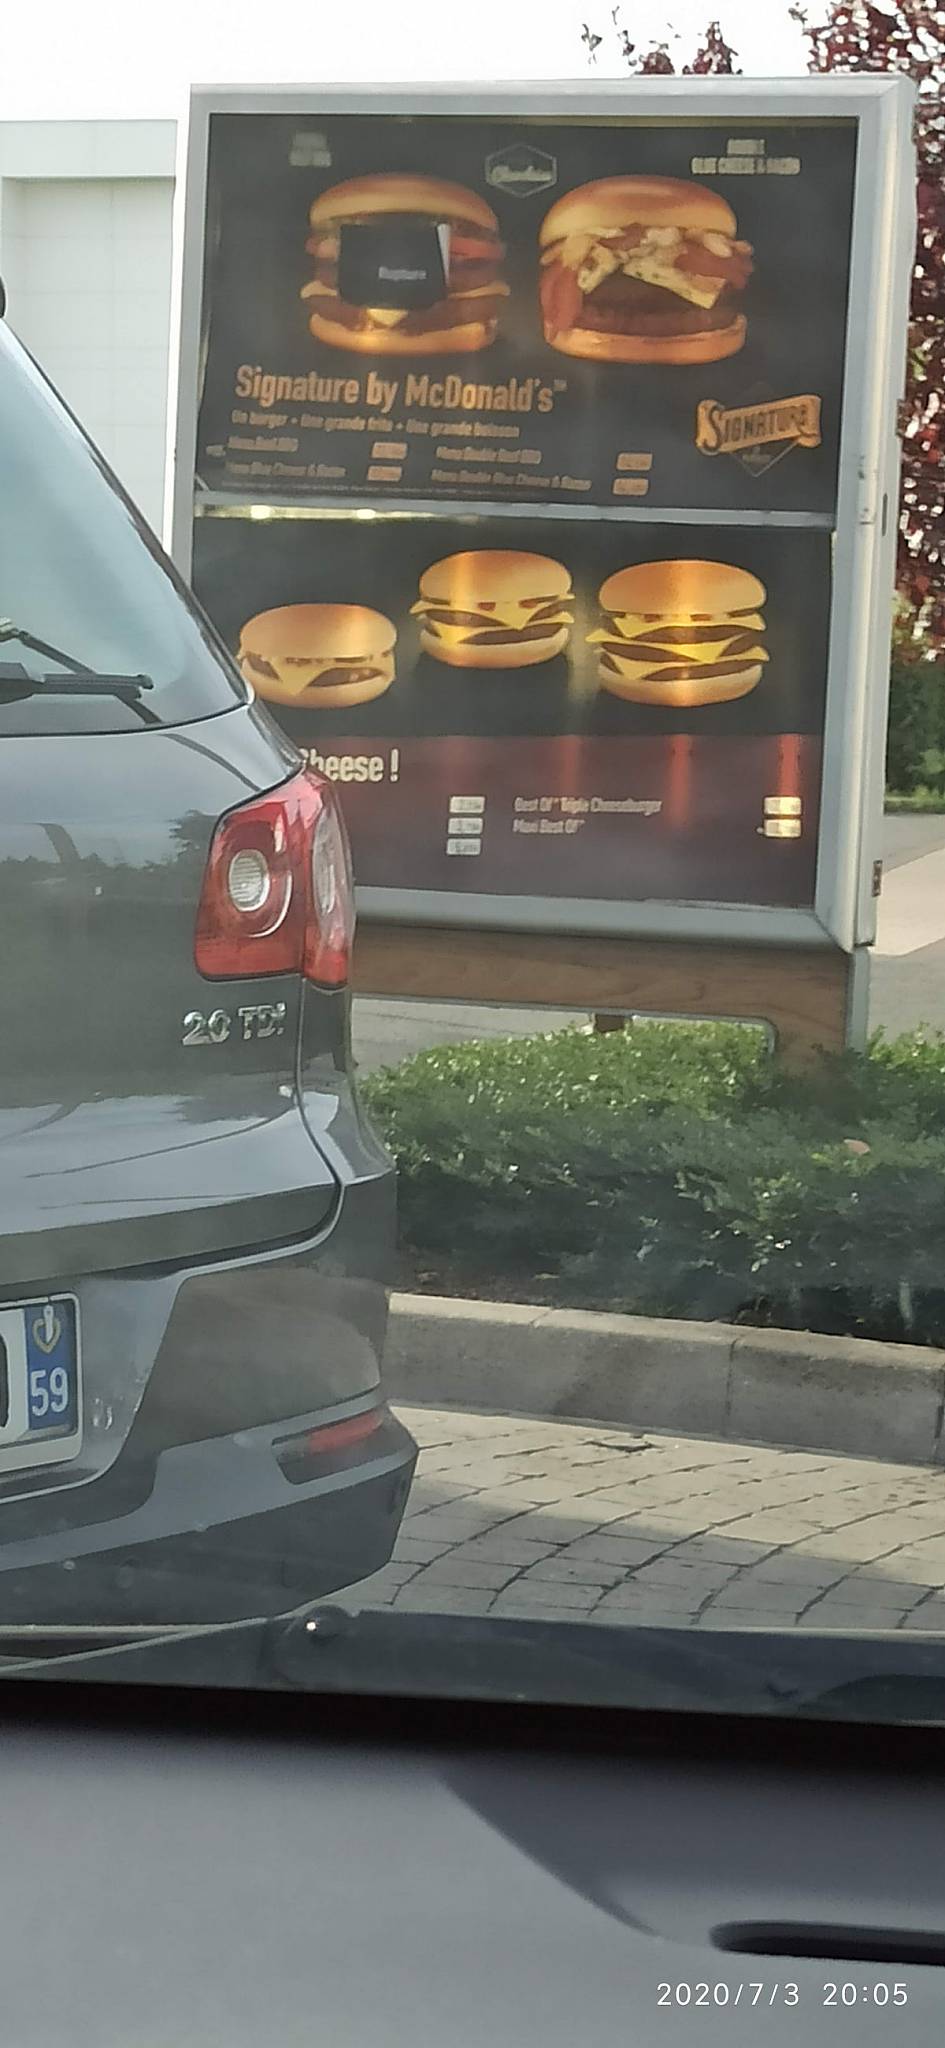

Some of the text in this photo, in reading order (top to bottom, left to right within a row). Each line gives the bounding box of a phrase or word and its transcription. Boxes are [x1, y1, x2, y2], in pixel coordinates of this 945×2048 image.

[234, 364, 360, 408] Signature
[365, 371, 399, 413] by
[30, 1366, 69, 1416] 59
